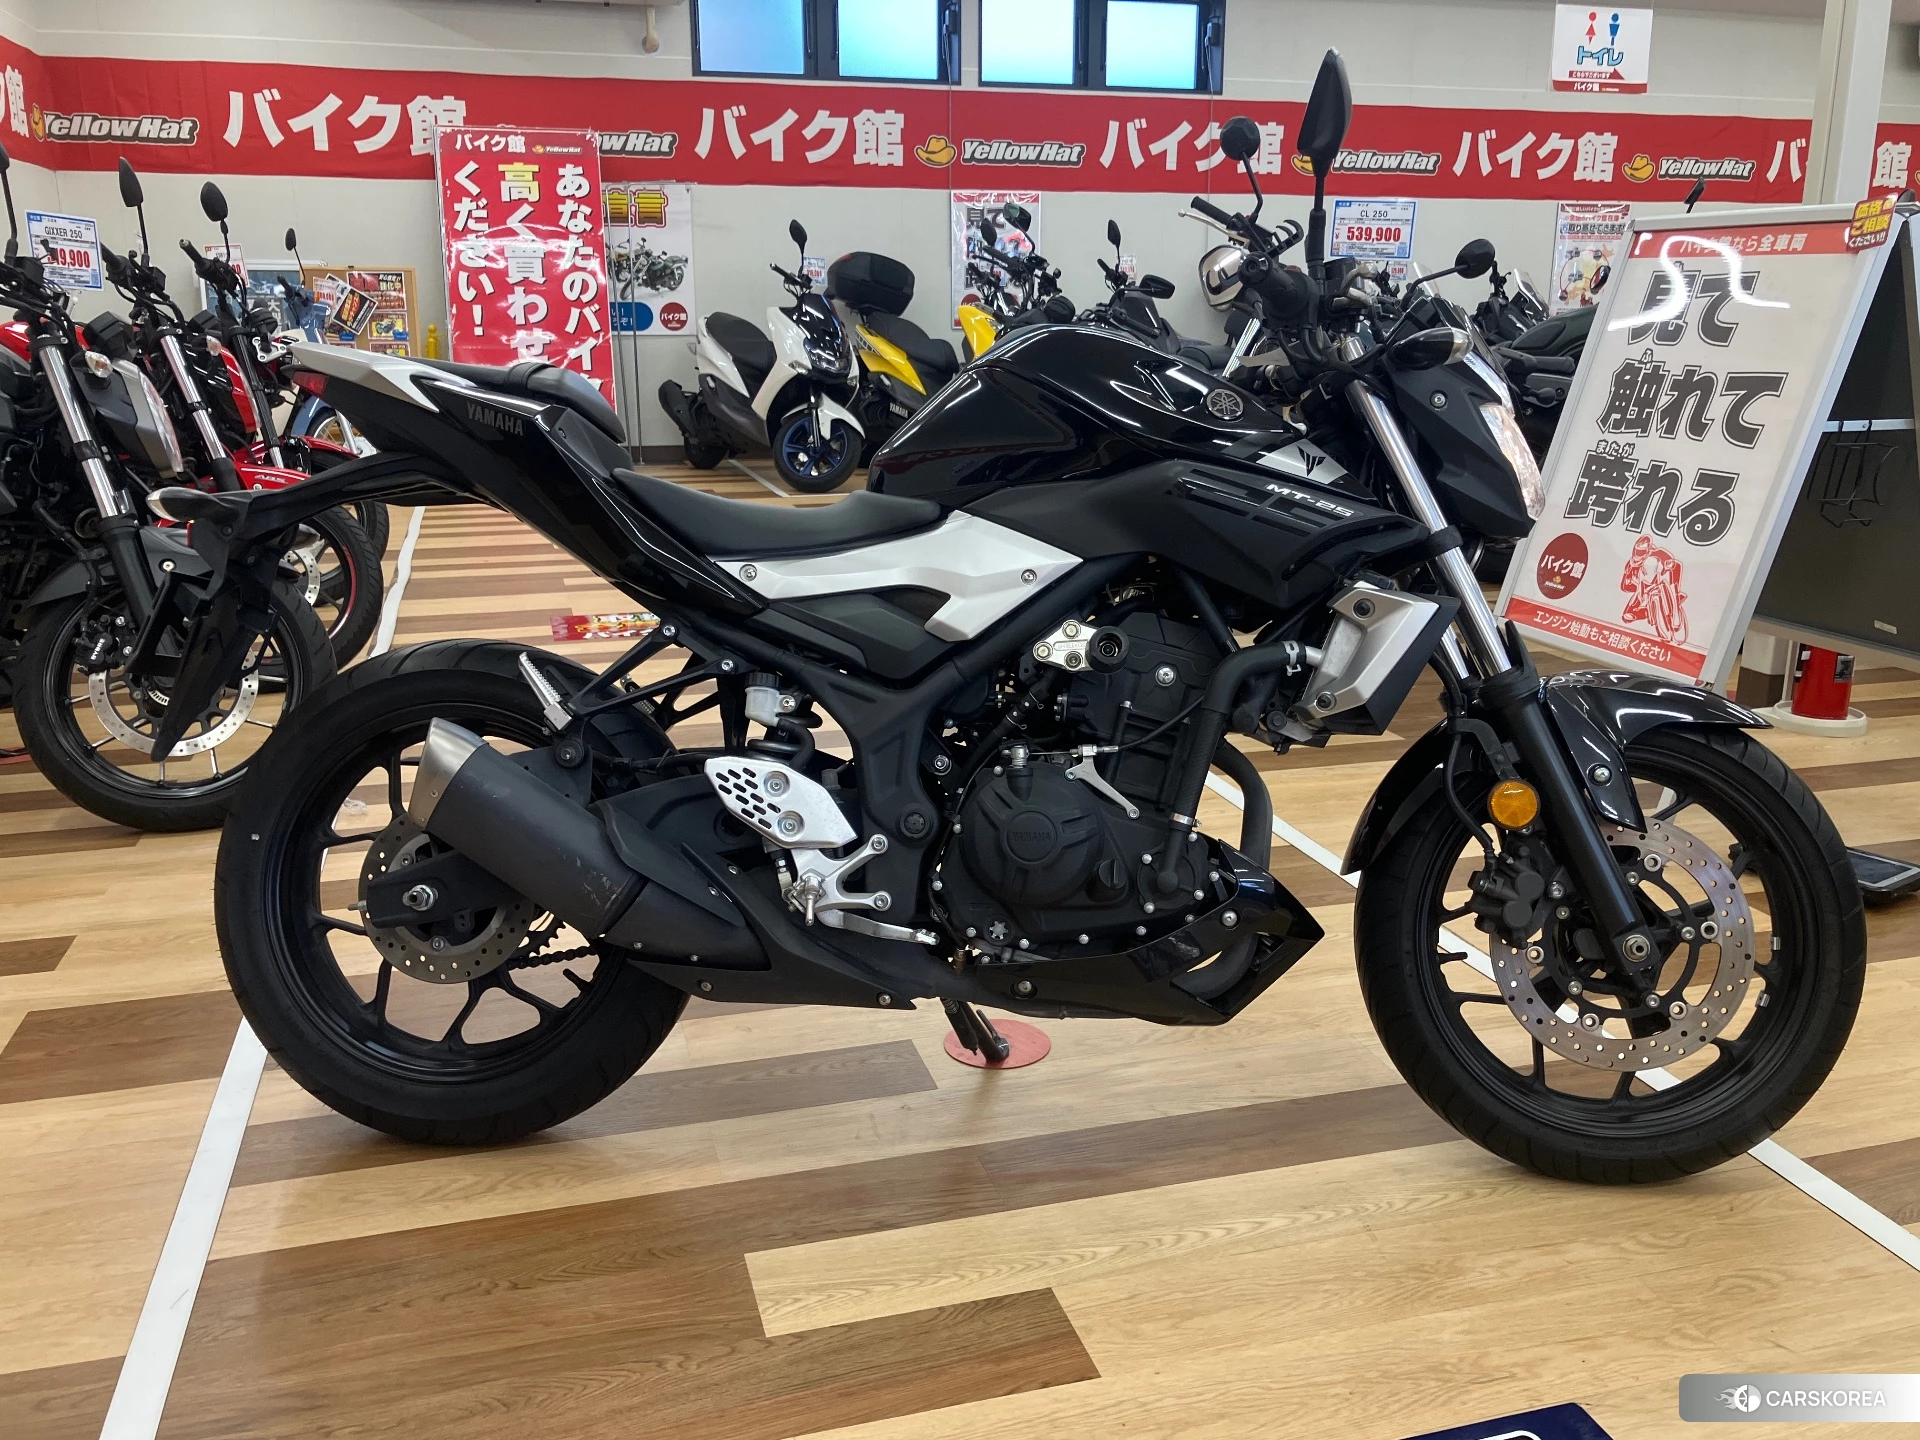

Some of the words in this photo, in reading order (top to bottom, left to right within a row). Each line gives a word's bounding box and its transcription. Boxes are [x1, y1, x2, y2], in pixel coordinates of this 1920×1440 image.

[1577, 46, 1624, 66] トイレ
[1573, 82, 1600, 92] バイク館
[45, 113, 193, 140] YellowHat
[223, 88, 466, 156] バイク館
[455, 134, 526, 153] バイク館
[694, 105, 904, 166] バイク館
[962, 141, 1082, 163] YellowHat
[1333, 151, 1438, 170] YellowHat
[1452, 129, 1618, 182] バイク館
[1659, 159, 1753, 177] YellowHat
[1360, 210, 1370, 218] CL
[1372, 210, 1388, 218] 250
[1850, 214, 1891, 236] ご相談
[44, 225, 68, 238] GIXXER
[69, 229, 83, 239] 250
[1346, 226, 1402, 243] 539,900
[660, 312, 688, 321] バイク館
[1628, 270, 1760, 347] 見て
[1597, 358, 1789, 450] 触れて
[466, 401, 524, 437] YAMAHA
[1596, 439, 1635, 457] またが
[1264, 483, 1355, 517] MT-25
[1541, 554, 1586, 579] バイク館
[1533, 611, 1671, 663] エンジン始動もご相談ください
